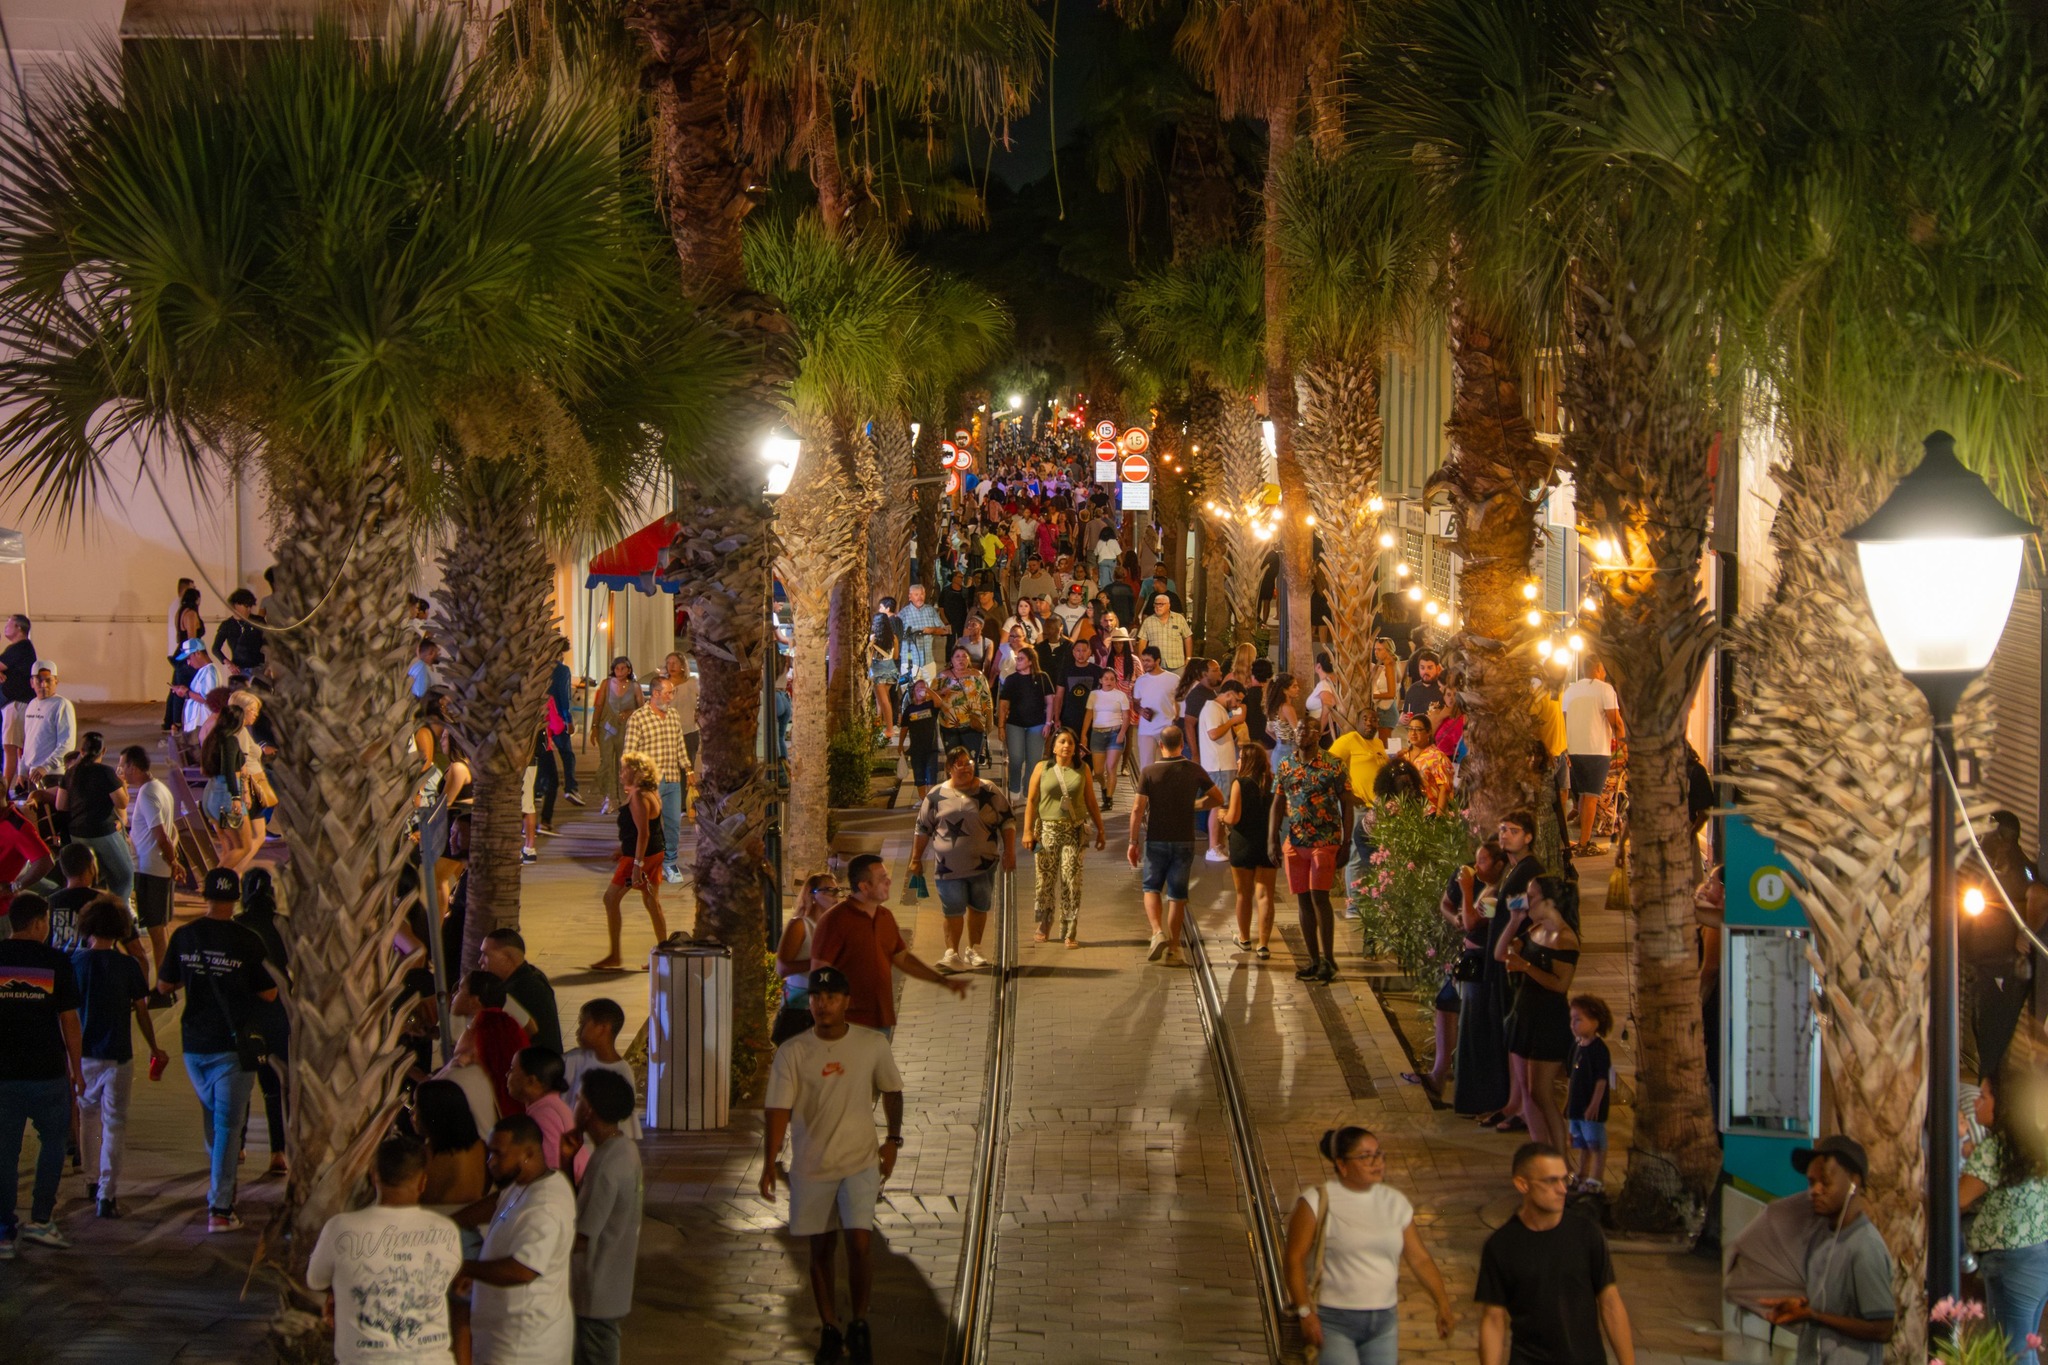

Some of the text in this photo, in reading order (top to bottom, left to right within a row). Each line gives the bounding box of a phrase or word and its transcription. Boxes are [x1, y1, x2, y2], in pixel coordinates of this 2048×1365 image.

[1101, 426, 1111, 435] 15
[1130, 436, 1142, 446] 15
[211, 956, 243, 968] QUALITY
[334, 1224, 458, 1261] Wyoming
